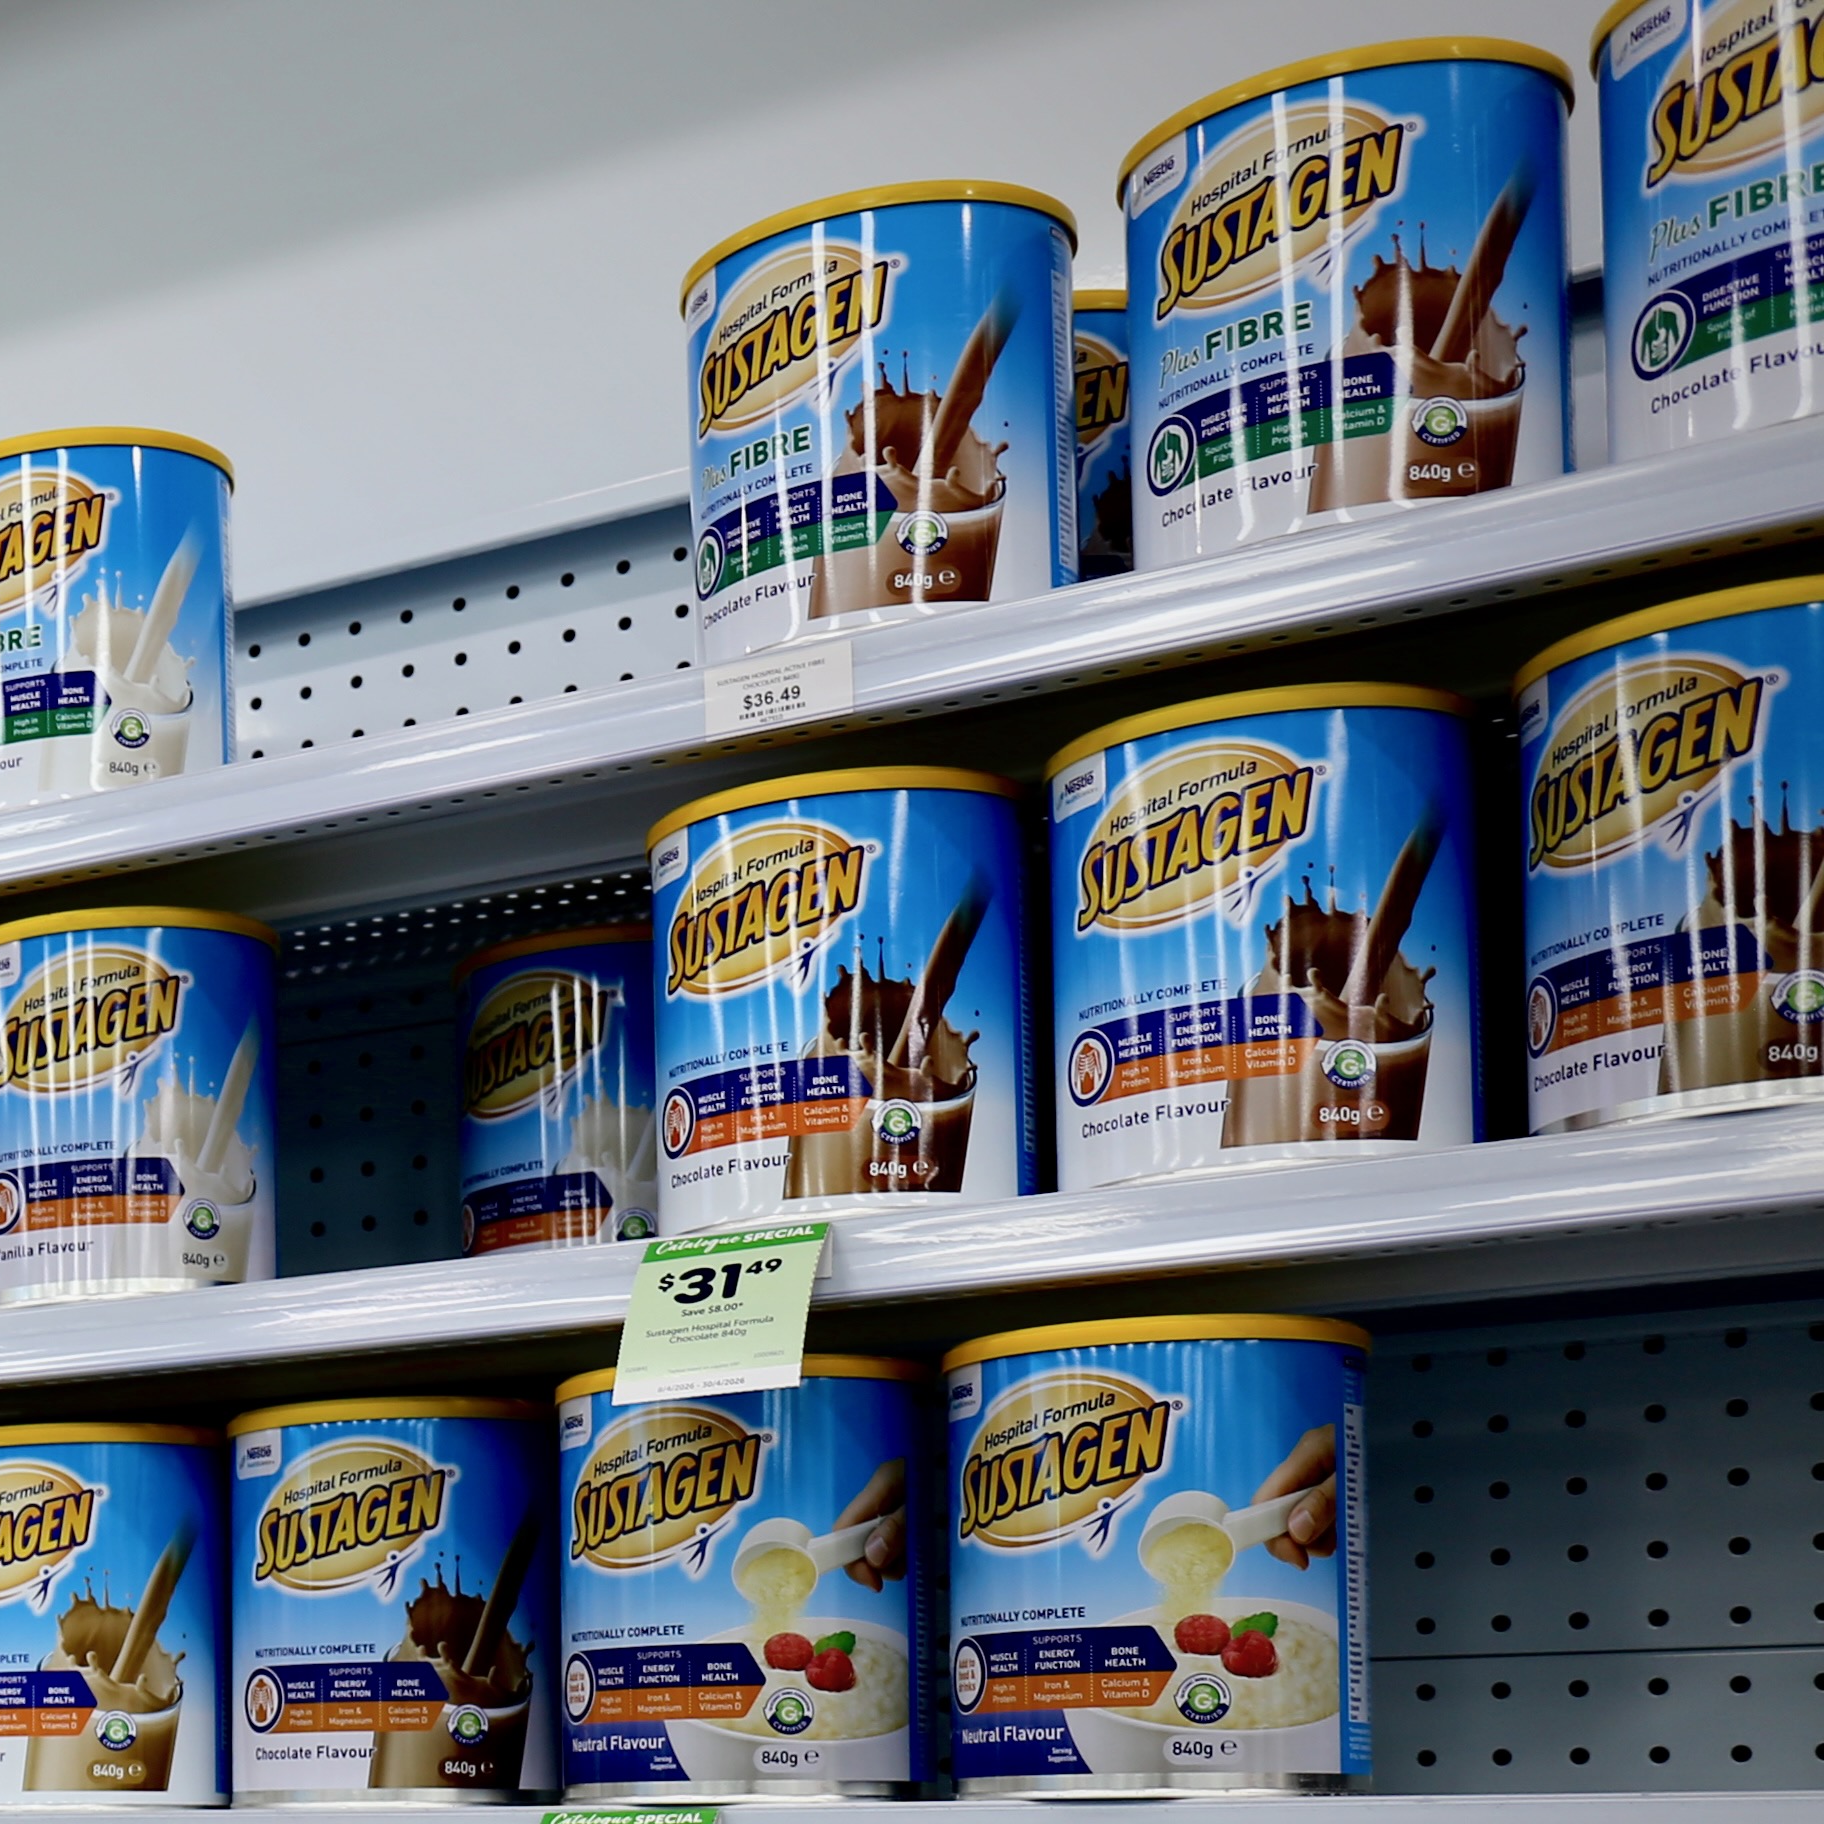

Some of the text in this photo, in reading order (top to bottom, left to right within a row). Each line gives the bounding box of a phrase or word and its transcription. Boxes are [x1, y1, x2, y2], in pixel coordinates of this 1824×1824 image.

[1190, 121, 1345, 217] Hospital Formula
[1204, 302, 1312, 361] FIBRE
[1239, 342, 1314, 377] COMPLETE
[730, 426, 812, 478] FIBRE
[1409, 463, 1452, 483] 840g
[1161, 462, 1317, 528] Chocolate Flavour
[743, 685, 801, 710] $36.49
[1082, 1097, 1230, 1140] Chocolate Flavour
[670, 1151, 790, 1189] Chocolate Flavour
[38, 1237, 94, 1255] Flavour
[656, 1225, 814, 1255] Catalogue SPECIAL
[681, 1307, 706, 1318] Save
[645, 1315, 774, 1339] Sustagen Hospital Formula
[668, 1326, 748, 1345] Chocolate 840g
[984, 1392, 1116, 1453] Hospital Formula
[1022, 1607, 1086, 1622] COMPLETE
[1104, 1655, 1146, 1668] HEALTH
[1111, 1646, 1140, 1656] BONE
[961, 1724, 1065, 1745] Neutral Flavour
[1171, 1740, 1214, 1760] 840g
